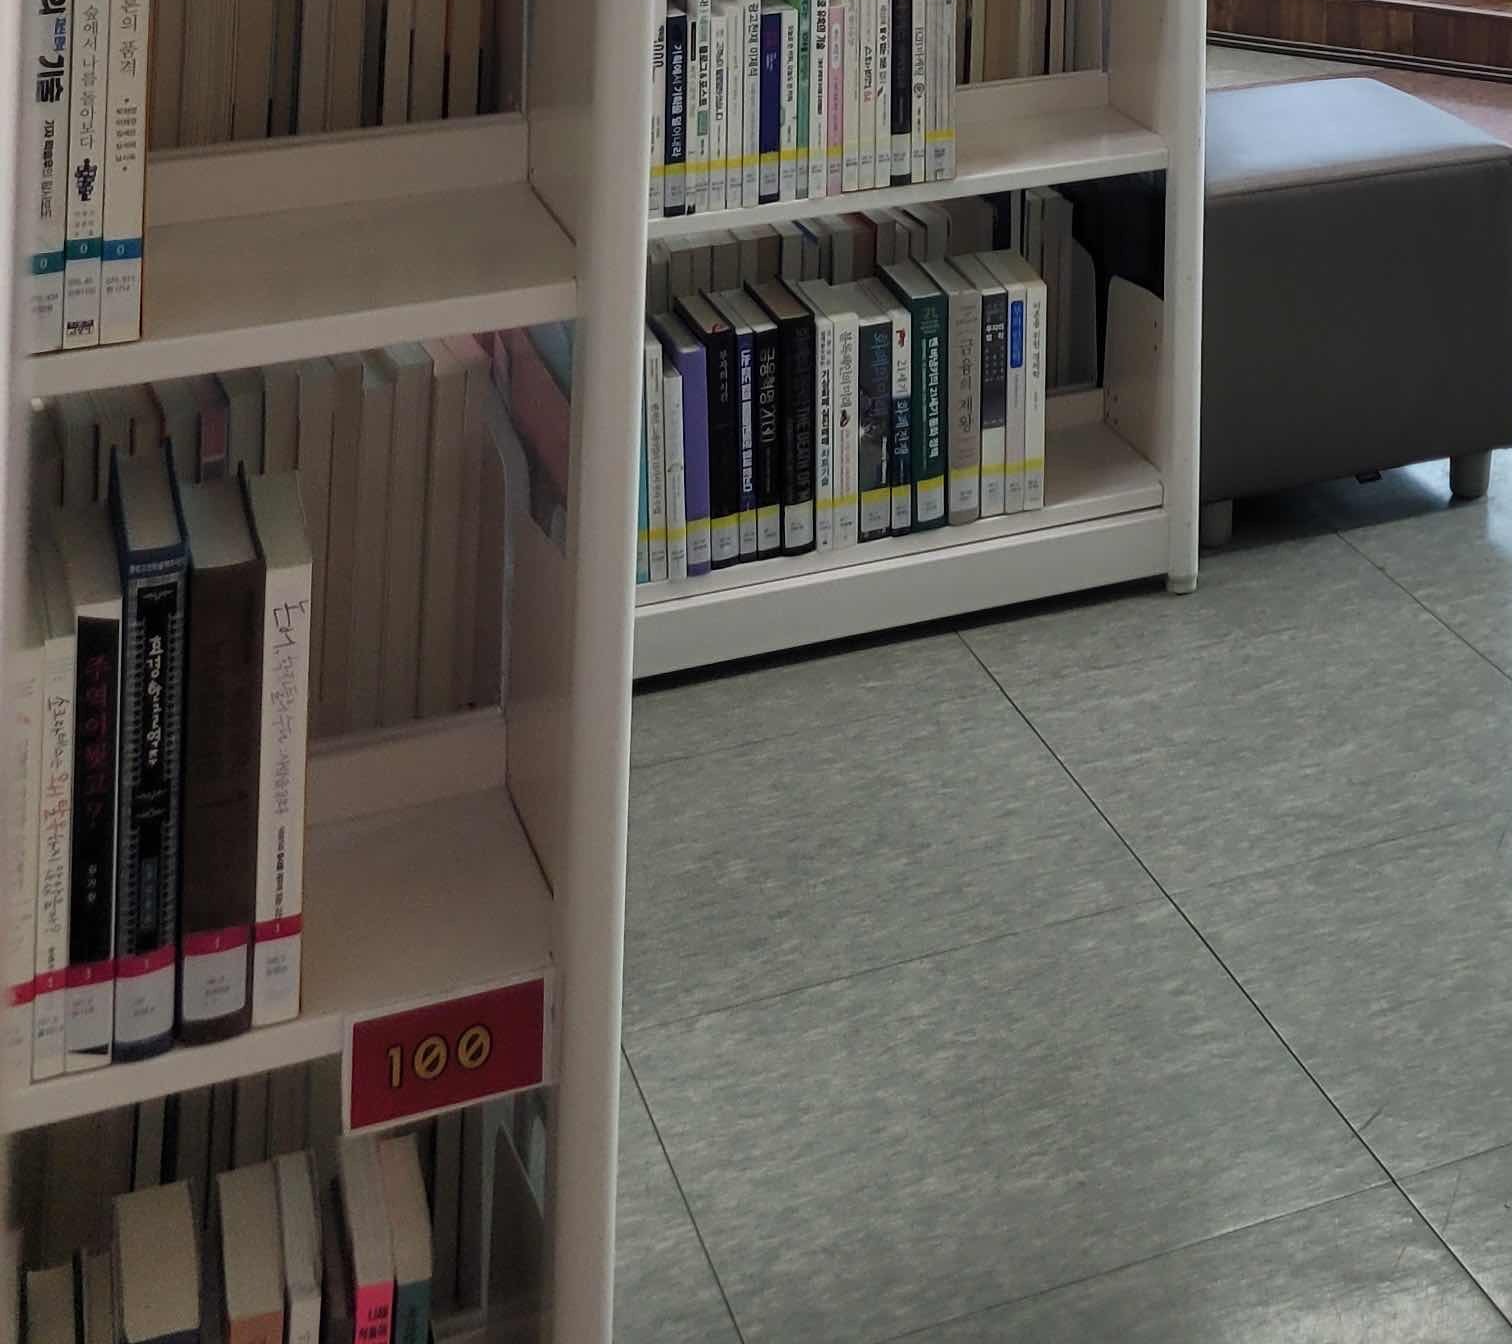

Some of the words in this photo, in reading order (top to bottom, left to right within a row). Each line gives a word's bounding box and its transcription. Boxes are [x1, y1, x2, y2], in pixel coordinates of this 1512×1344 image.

[748, 2, 759, 44] 광고천재
[37, 54, 66, 104] 기술
[748, 47, 759, 77] 이제석
[959, 337, 975, 390] 금융의
[387, 1025, 492, 1088] 100
